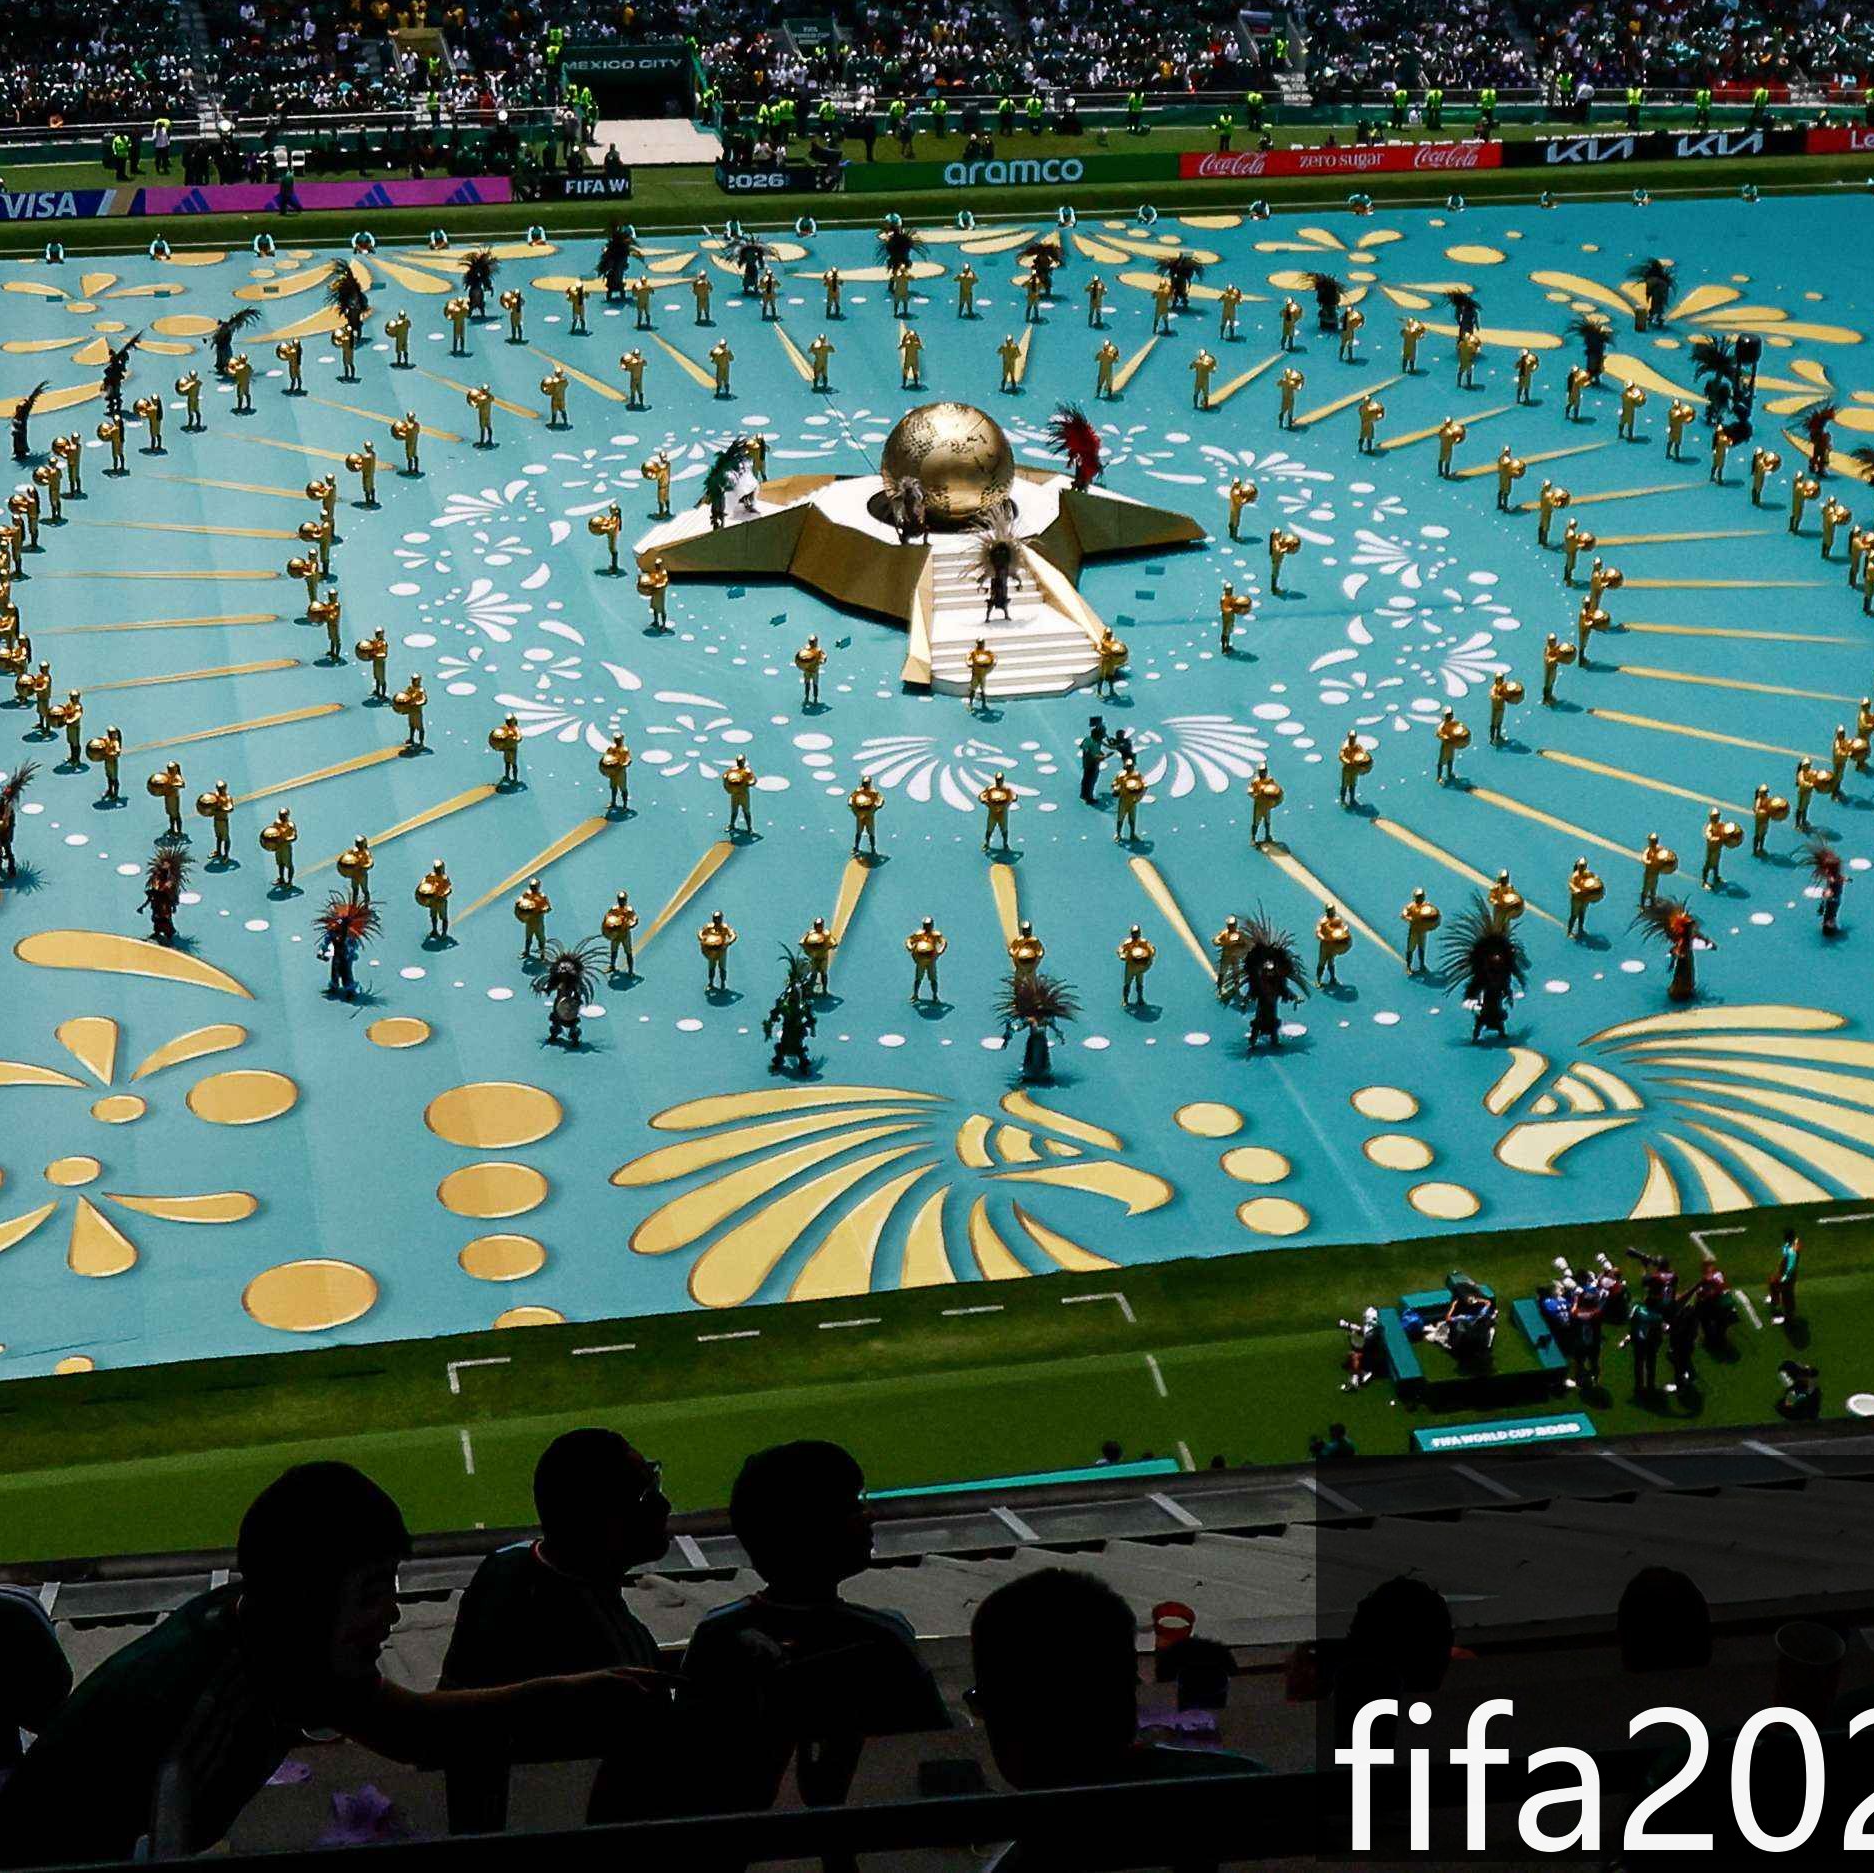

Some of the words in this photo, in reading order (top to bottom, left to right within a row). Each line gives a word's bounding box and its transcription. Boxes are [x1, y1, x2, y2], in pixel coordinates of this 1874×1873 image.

[562, 58, 635, 71] MEXICO
[638, 58, 683, 70] CITY
[1546, 135, 1636, 164] KIA
[1676, 130, 1766, 159] KIA
[1299, 154, 1336, 169] zero
[1339, 151, 1385, 170] sugar
[943, 158, 1084, 186] aramco
[565, 177, 606, 194] FIFA
[1430, 1436, 1462, 1448] FIFA
[1462, 1431, 1508, 1446] WORLD
[1508, 1427, 1534, 1441] CUP
